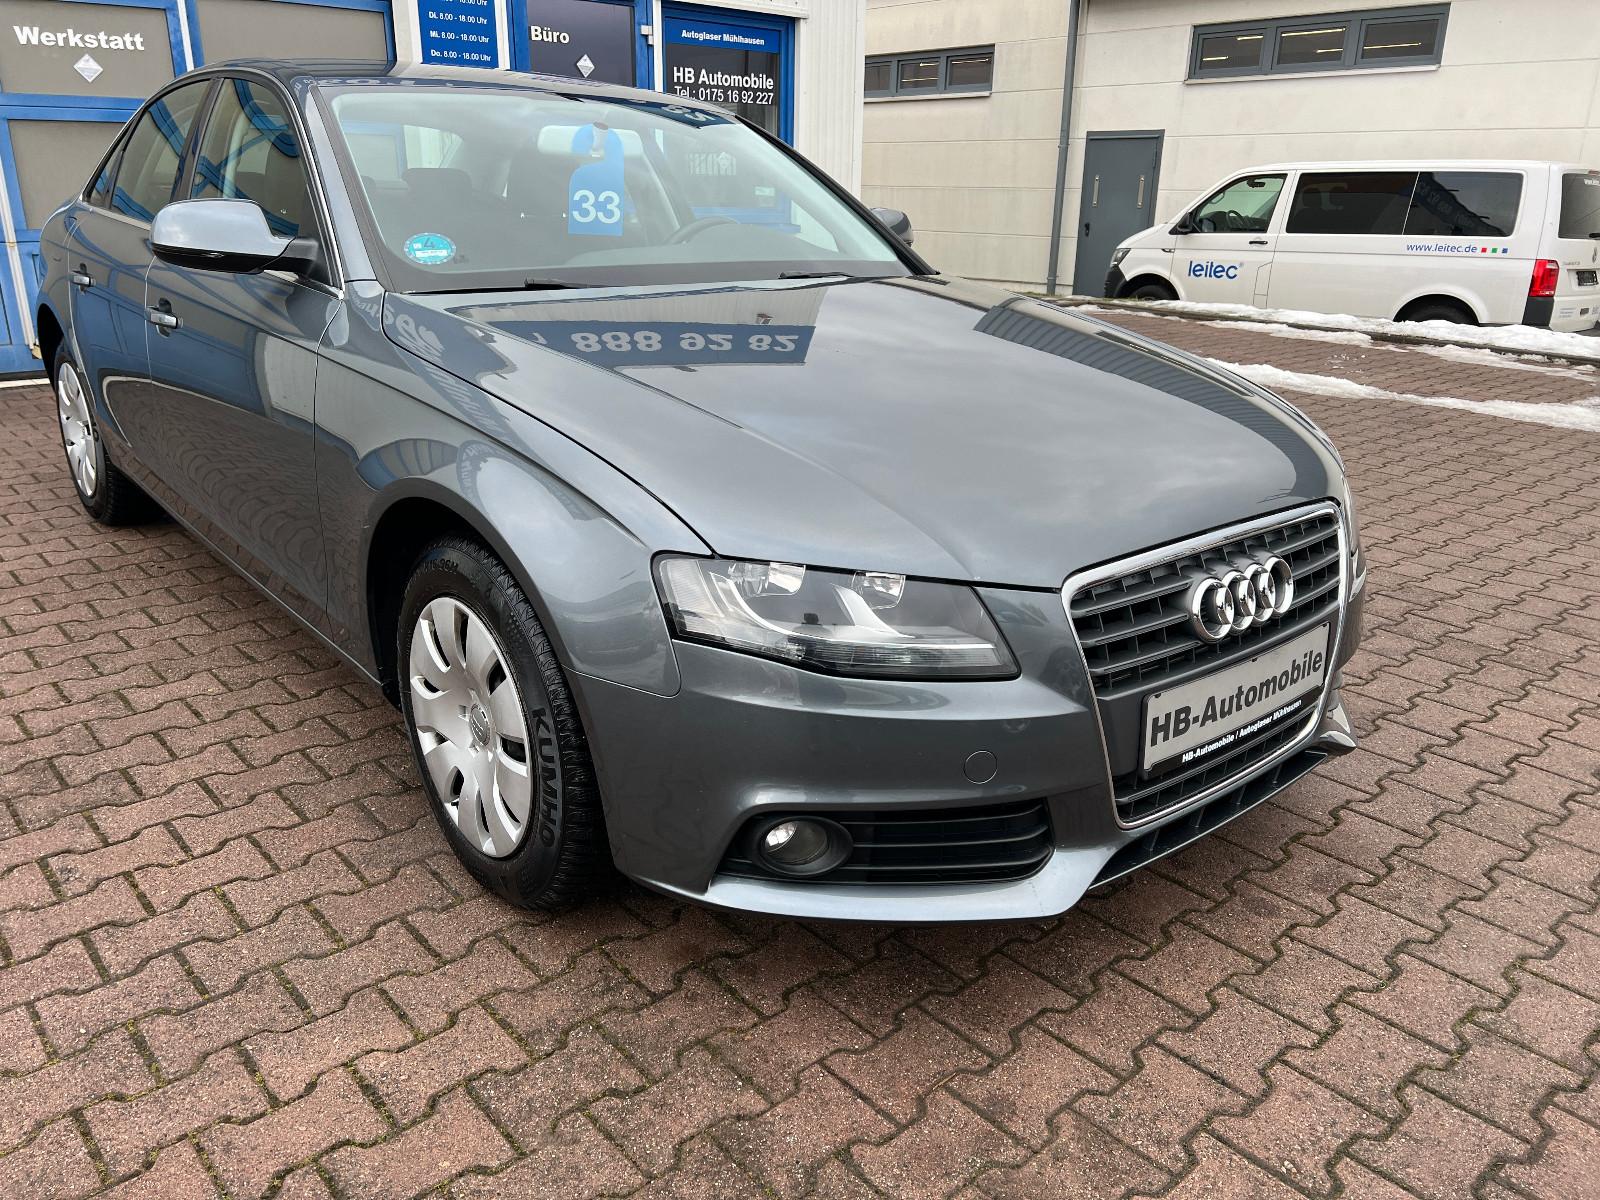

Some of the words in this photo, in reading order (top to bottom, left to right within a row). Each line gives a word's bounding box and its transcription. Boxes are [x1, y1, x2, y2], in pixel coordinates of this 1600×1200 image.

[459, 15, 475, 23] 18.00
[13, 25, 144, 50] Werkstatt
[531, 25, 570, 43] Büro
[682, 30, 721, 40] Autoglaser
[723, 34, 764, 45] Mühlhausen
[673, 67, 694, 84] HB
[698, 69, 774, 89] Automobile
[699, 88, 724, 102] 0175
[727, 90, 739, 102] 16
[741, 91, 754, 104] 92
[756, 92, 773, 104] 227
[572, 189, 620, 224] 33
[1407, 244, 1477, 253] www.leitec.de
[1188, 260, 1238, 279] leitec
[1150, 650, 1323, 747] HB-Automobile
[1182, 734, 1235, 763] HB-Automobile
[1239, 715, 1273, 738] Autoglaser
[532, 708, 558, 848] KUMHO
